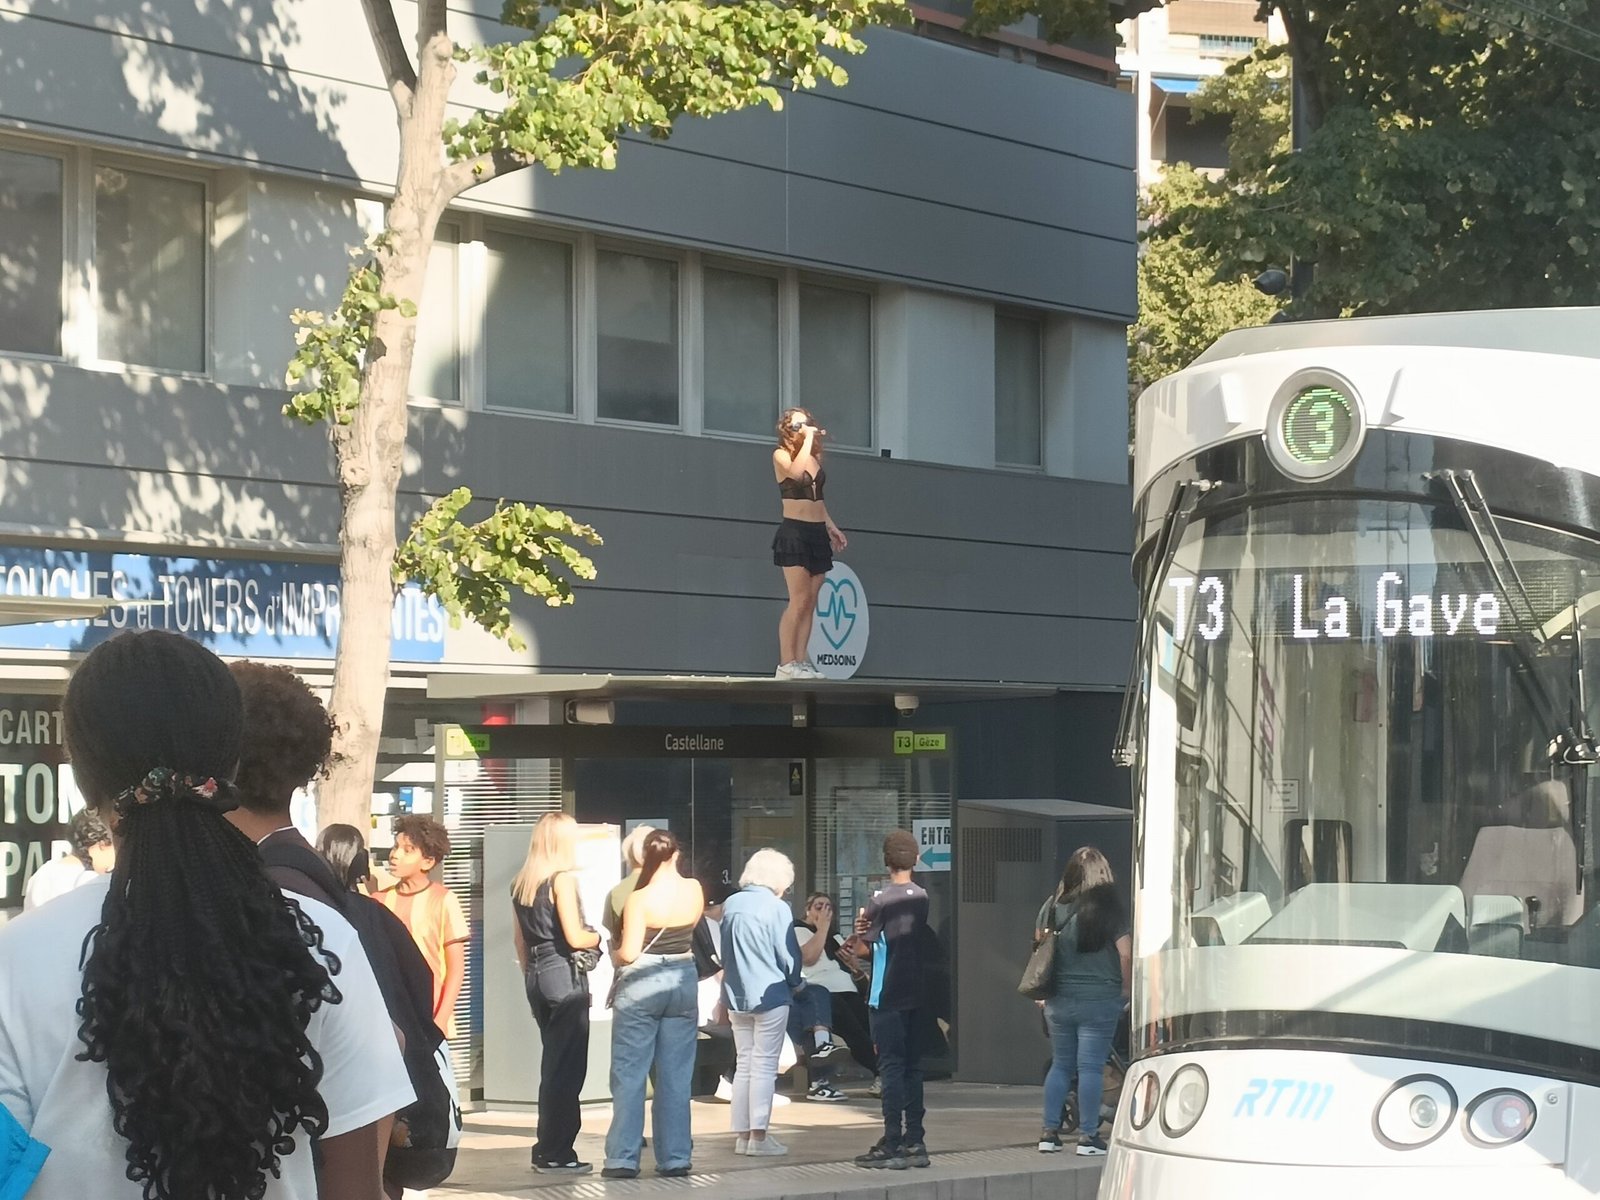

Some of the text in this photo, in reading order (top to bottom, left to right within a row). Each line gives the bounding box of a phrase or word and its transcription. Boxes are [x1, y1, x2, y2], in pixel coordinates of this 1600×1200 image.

[1308, 401, 1334, 453] 3
[158, 574, 261, 636] TONERS
[1168, 571, 1500, 640] T3 La Gaye
[816, 653, 857, 667] MEDSOINS
[664, 733, 725, 751] Castellane
[896, 736, 912, 749] T3
